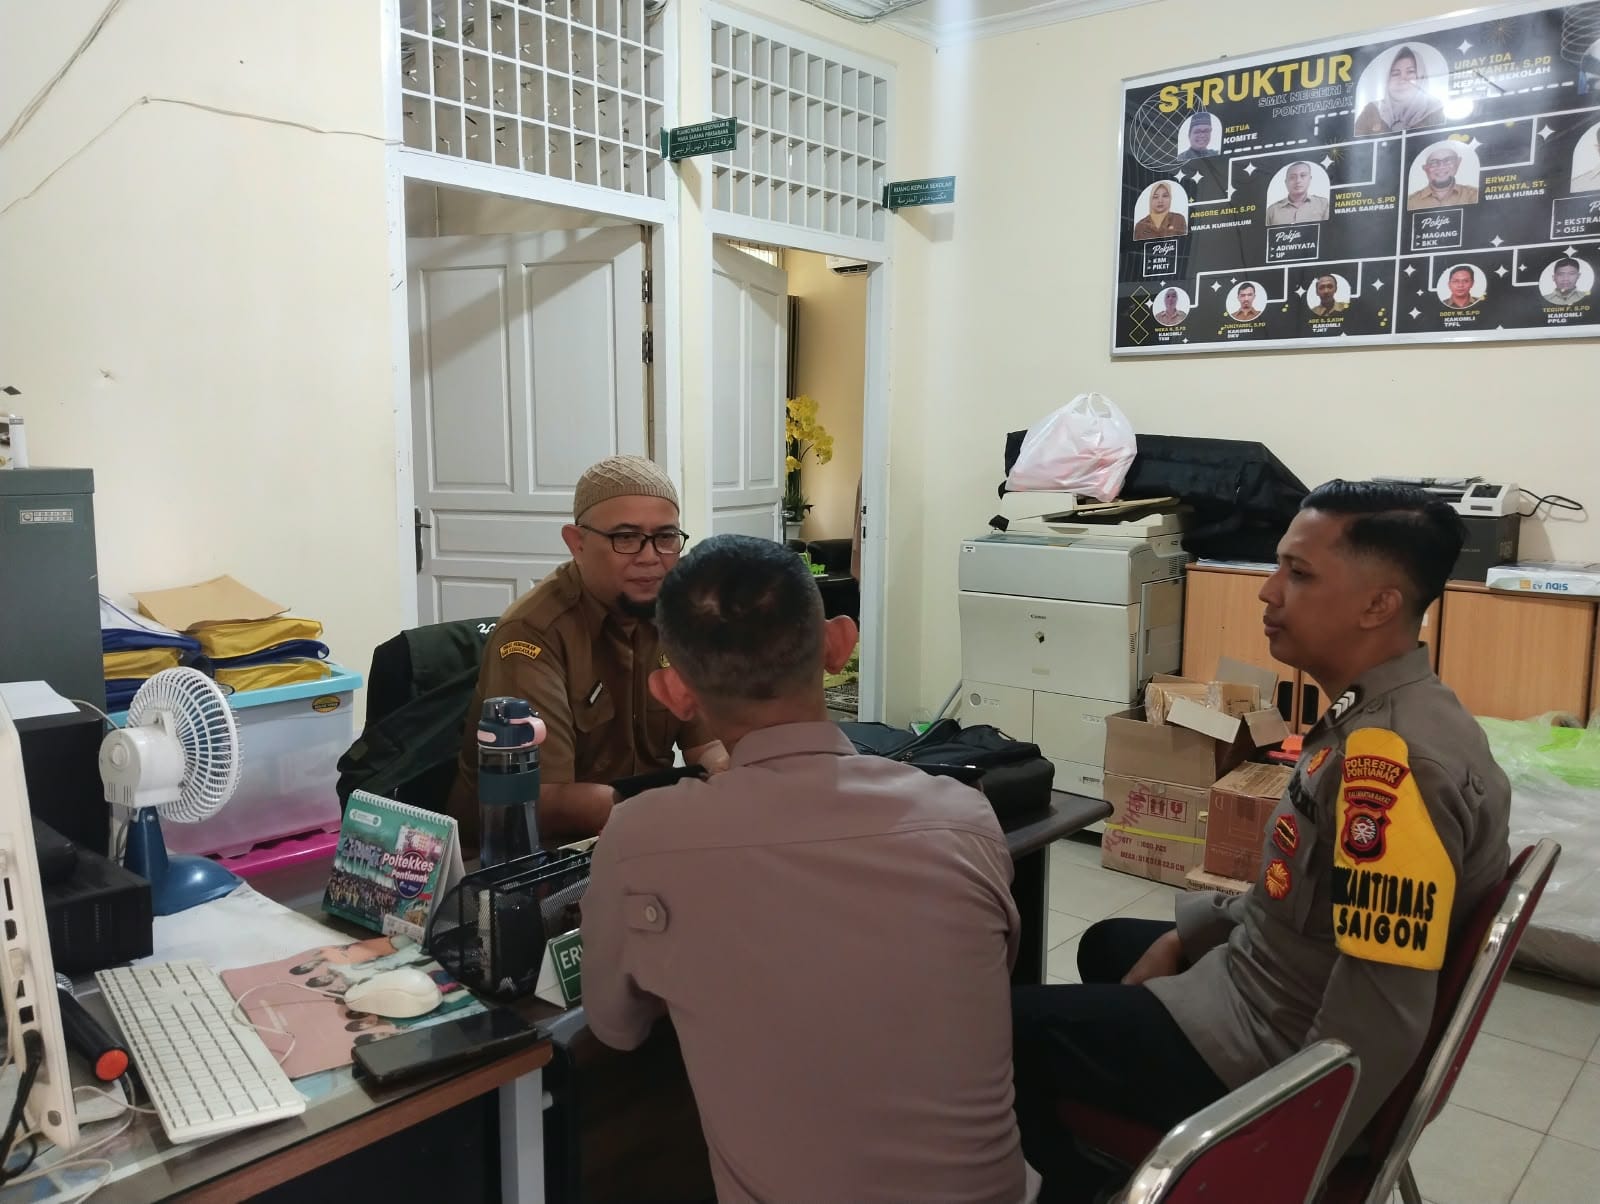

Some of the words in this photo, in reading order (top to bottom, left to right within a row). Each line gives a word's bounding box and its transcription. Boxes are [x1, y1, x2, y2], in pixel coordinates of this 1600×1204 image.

[1489, 52, 1512, 64] IDA
[1523, 55, 1552, 69] S.PD
[1498, 66, 1551, 81] SEKOLAH
[1158, 54, 1353, 113] STRUKTUR
[1258, 93, 1289, 107] SMK
[1290, 85, 1342, 103] NEGERI
[1273, 96, 1354, 118] PONTIANAK
[1225, 123, 1250, 134] KETUA
[1223, 132, 1258, 145] KOMITE
[1485, 174, 1517, 185] ERWIN
[1335, 192, 1362, 200] WIDYO
[1377, 196, 1396, 204] S.PD
[1485, 193, 1511, 201] WAKA
[1513, 189, 1544, 198] HUMAS
[1240, 205, 1256, 213] S.PD
[1359, 204, 1395, 212] SARPRAS
[1211, 219, 1252, 229] KURIKULUM
[1421, 215, 1450, 230] Pokja
[1422, 230, 1458, 239] MAGANG
[1563, 225, 1585, 234] OSIS
[1275, 230, 1301, 242] Pokja
[1152, 242, 1175, 256] Pokja
[1276, 242, 1316, 251] ADIWIYATA
[1345, 758, 1401, 775] POLRESTA
[1346, 767, 1398, 784] PONTIANAK
[1375, 793, 1392, 805] BARAT
[381, 853, 434, 872] Poltekkes
[391, 869, 429, 884] Pontianak
[1336, 907, 1428, 951] SAIGON
